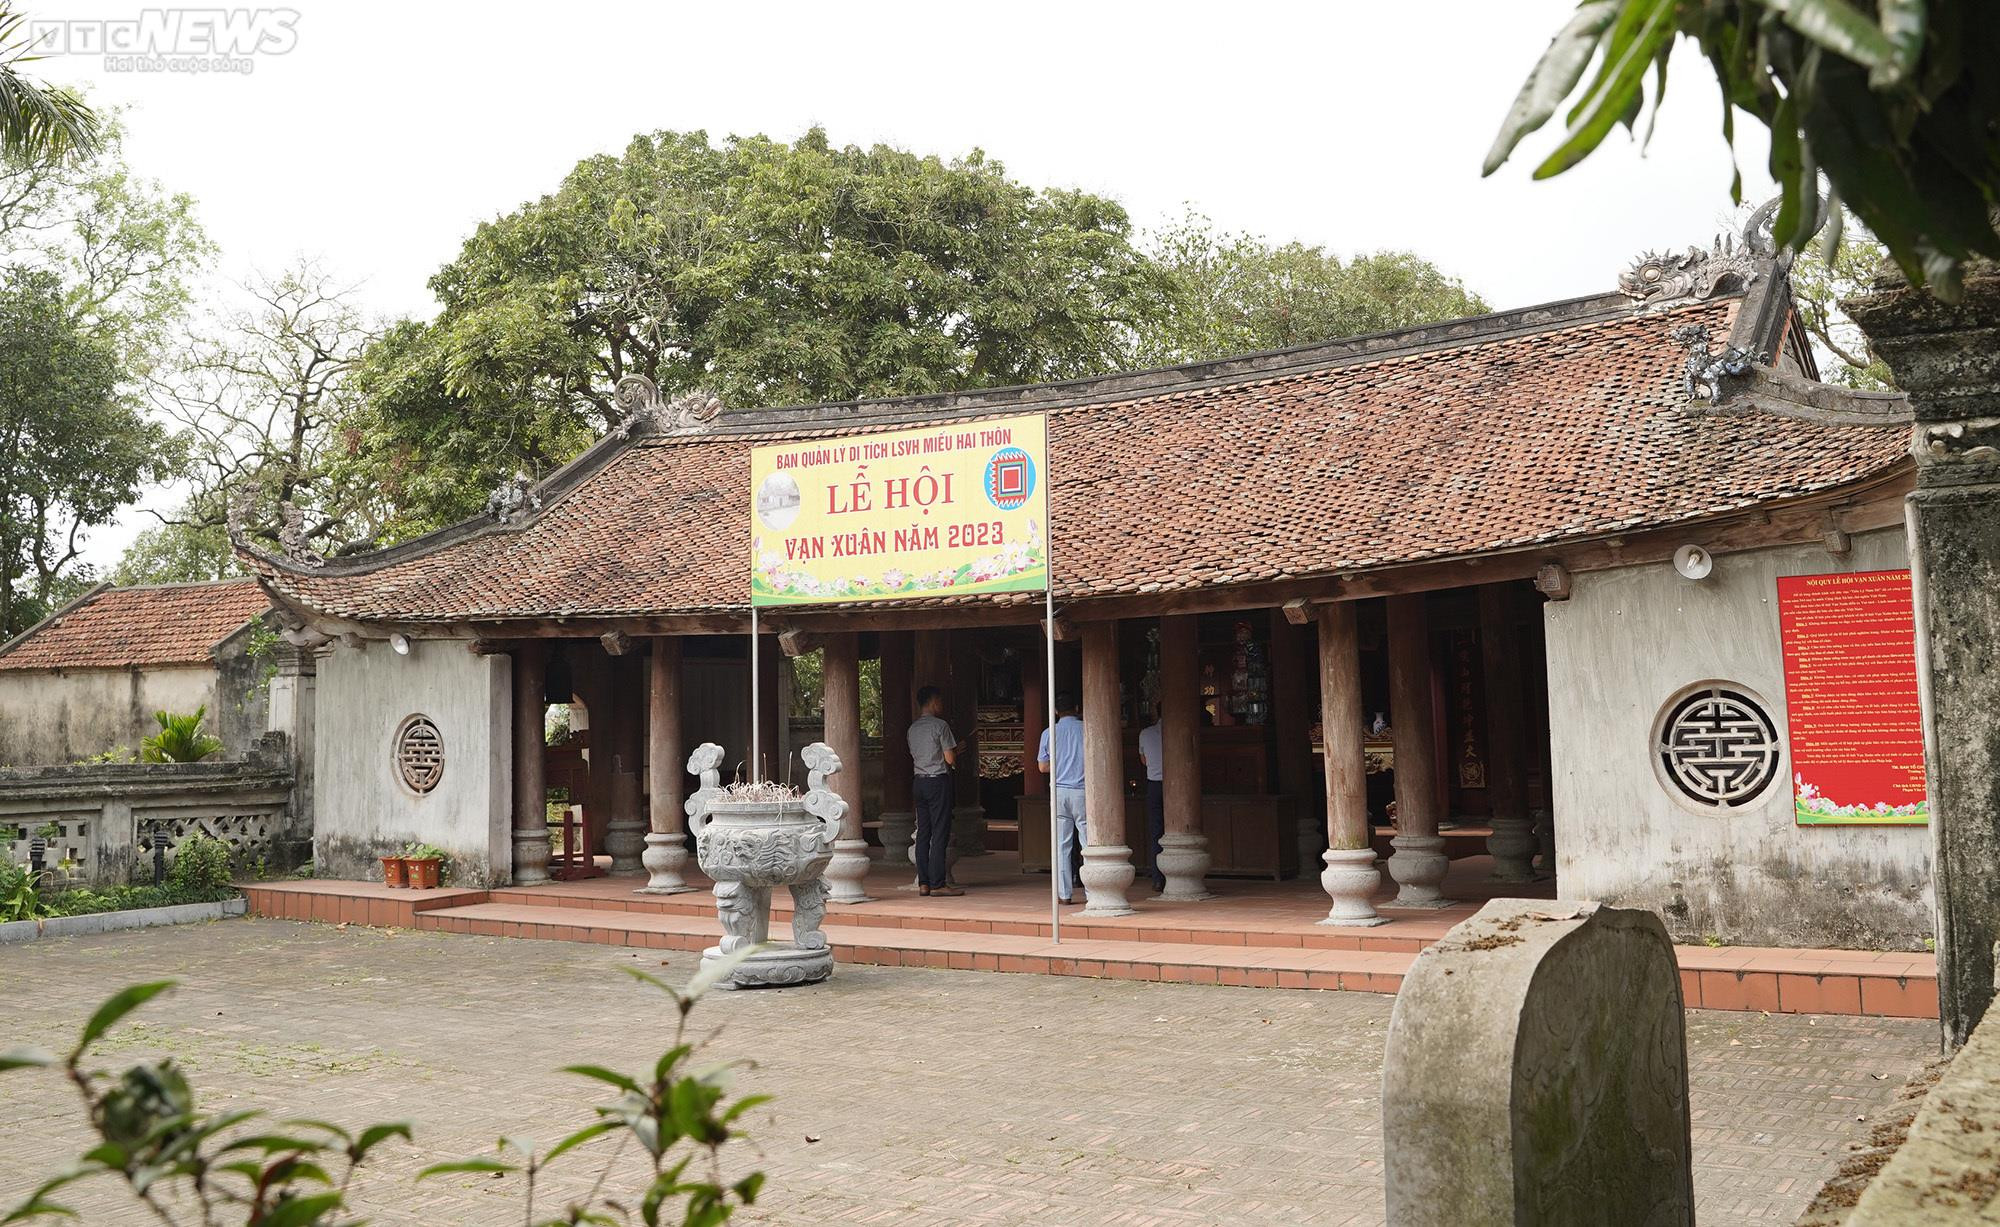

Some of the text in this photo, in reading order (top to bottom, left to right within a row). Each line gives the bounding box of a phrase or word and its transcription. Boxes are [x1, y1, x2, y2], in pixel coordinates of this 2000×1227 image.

[776, 427, 1012, 469] BAN QUẢN LÝ DI TÍCH LSVH MIẾU HAI THÔN
[826, 464, 954, 515] LỄ HỘI
[785, 521, 1004, 564] VẠN XUÂN NĂM 2023
